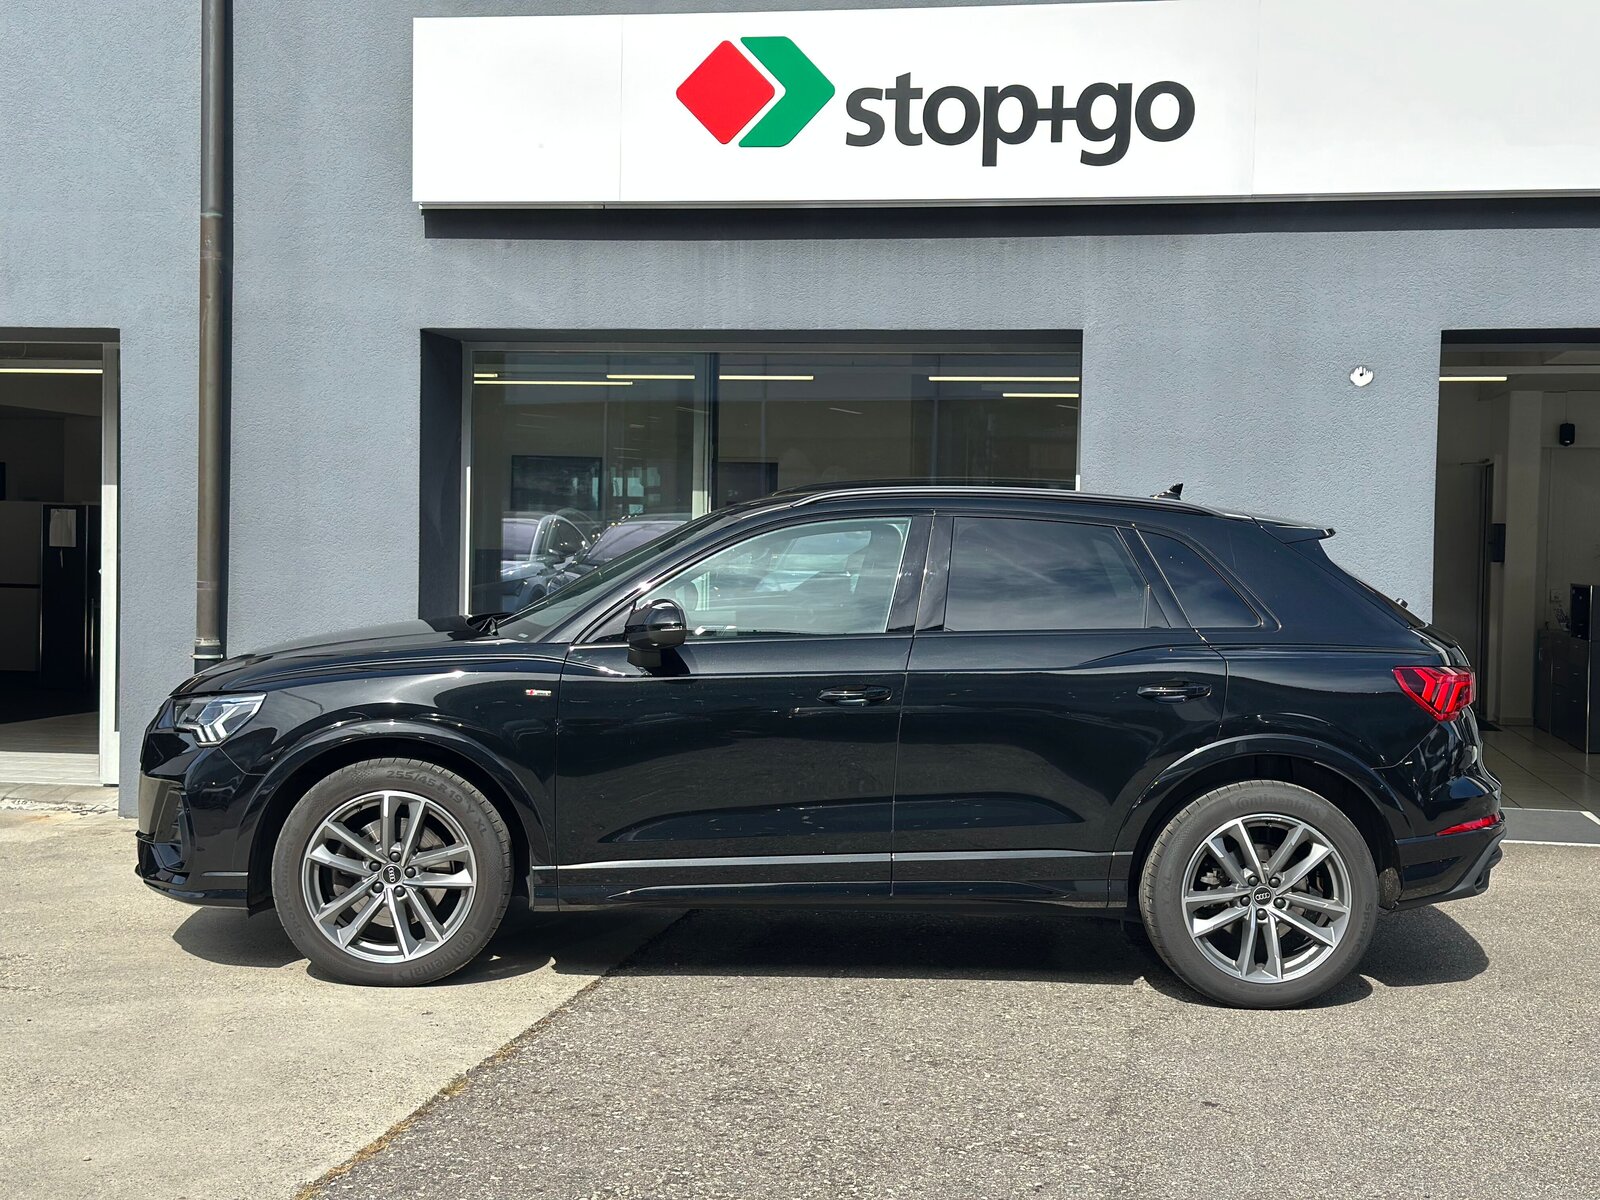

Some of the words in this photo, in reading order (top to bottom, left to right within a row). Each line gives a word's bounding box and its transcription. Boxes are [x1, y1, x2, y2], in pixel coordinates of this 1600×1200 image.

[846, 72, 1195, 167] stop+go
[386, 769, 436, 787] 255/45
[437, 782, 448, 793] R
[447, 788, 464, 804] 19
[473, 817, 489, 837] XL
